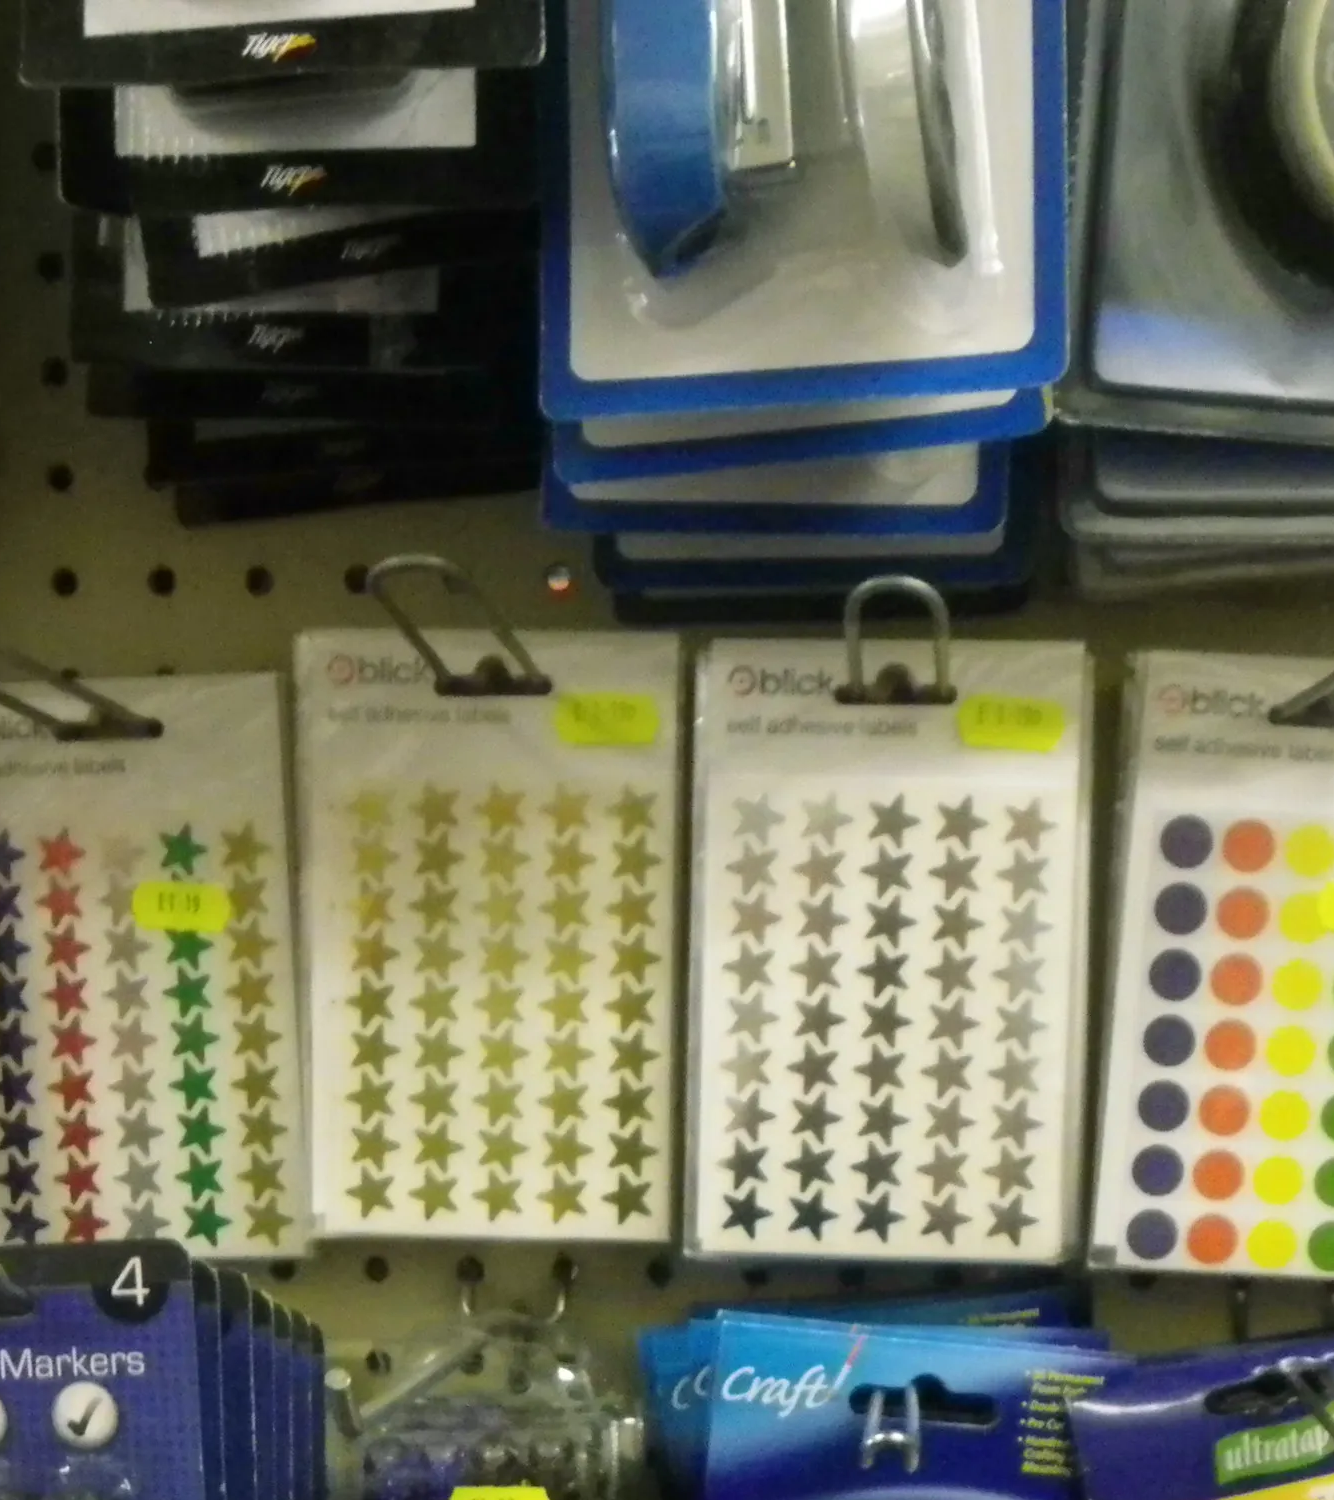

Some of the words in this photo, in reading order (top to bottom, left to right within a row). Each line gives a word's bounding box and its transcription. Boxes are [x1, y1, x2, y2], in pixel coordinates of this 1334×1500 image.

[758, 667, 834, 696] blick
[110, 1255, 150, 1306] 4
[0, 1347, 145, 1380] Markers
[1223, 1424, 1334, 1471] ultratap
